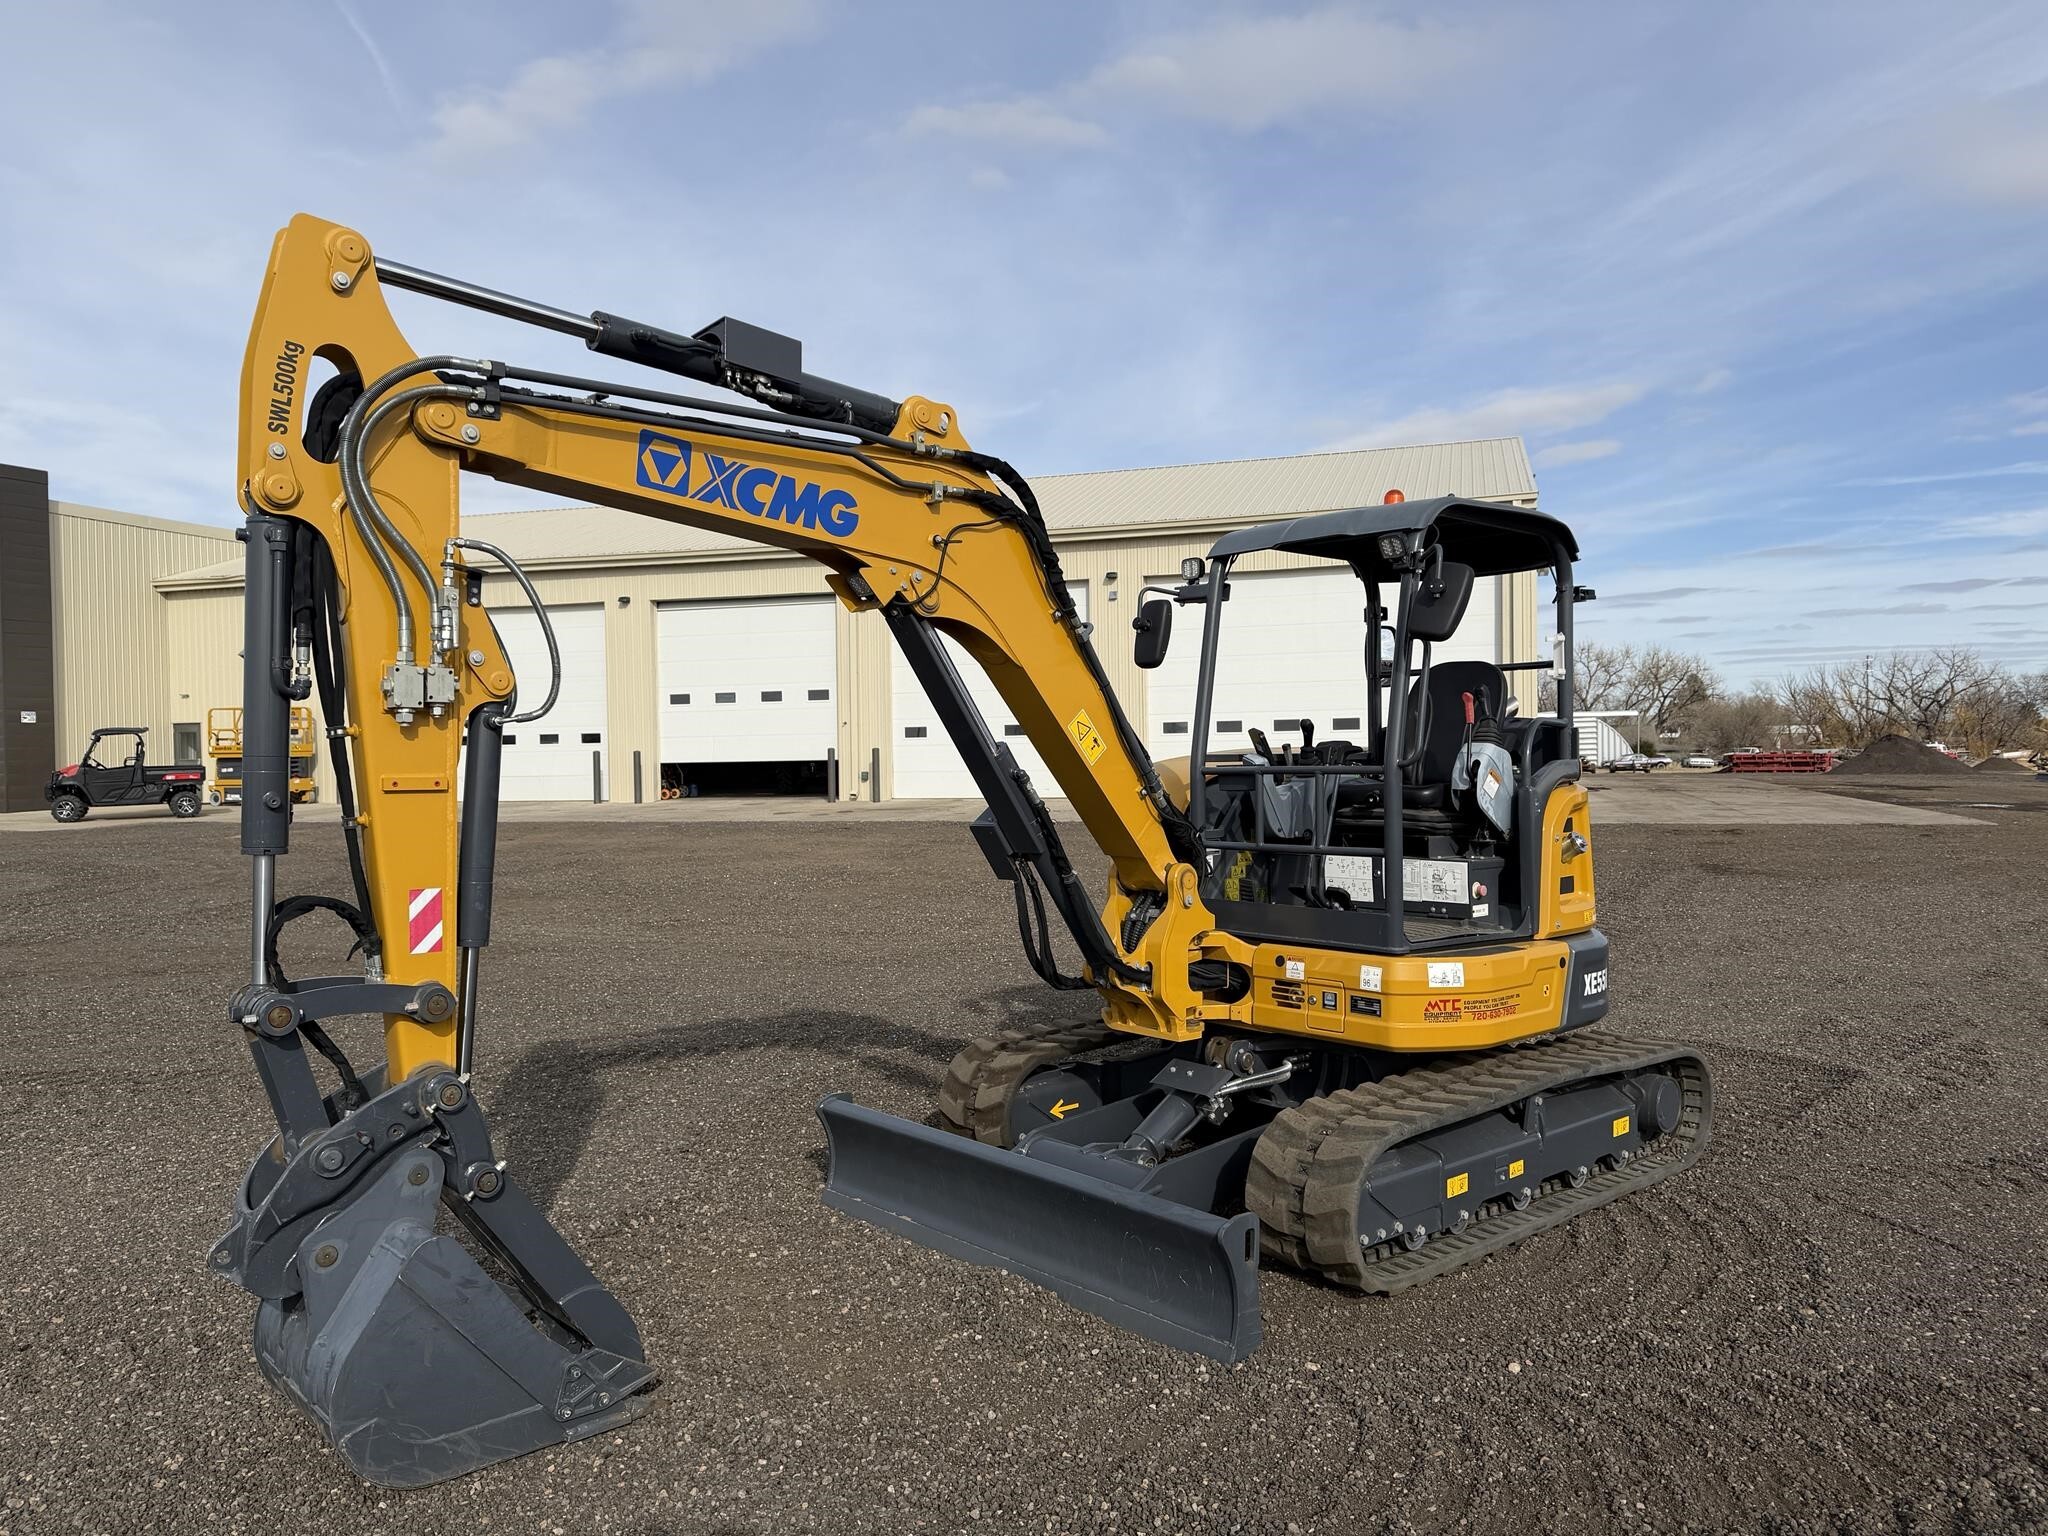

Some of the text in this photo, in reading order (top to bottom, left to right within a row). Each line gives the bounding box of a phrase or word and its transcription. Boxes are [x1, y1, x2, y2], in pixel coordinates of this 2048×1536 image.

[268, 340, 305, 435] SWL500kg
[689, 451, 859, 538] XCMG
[1424, 999, 1462, 1011] MTC
